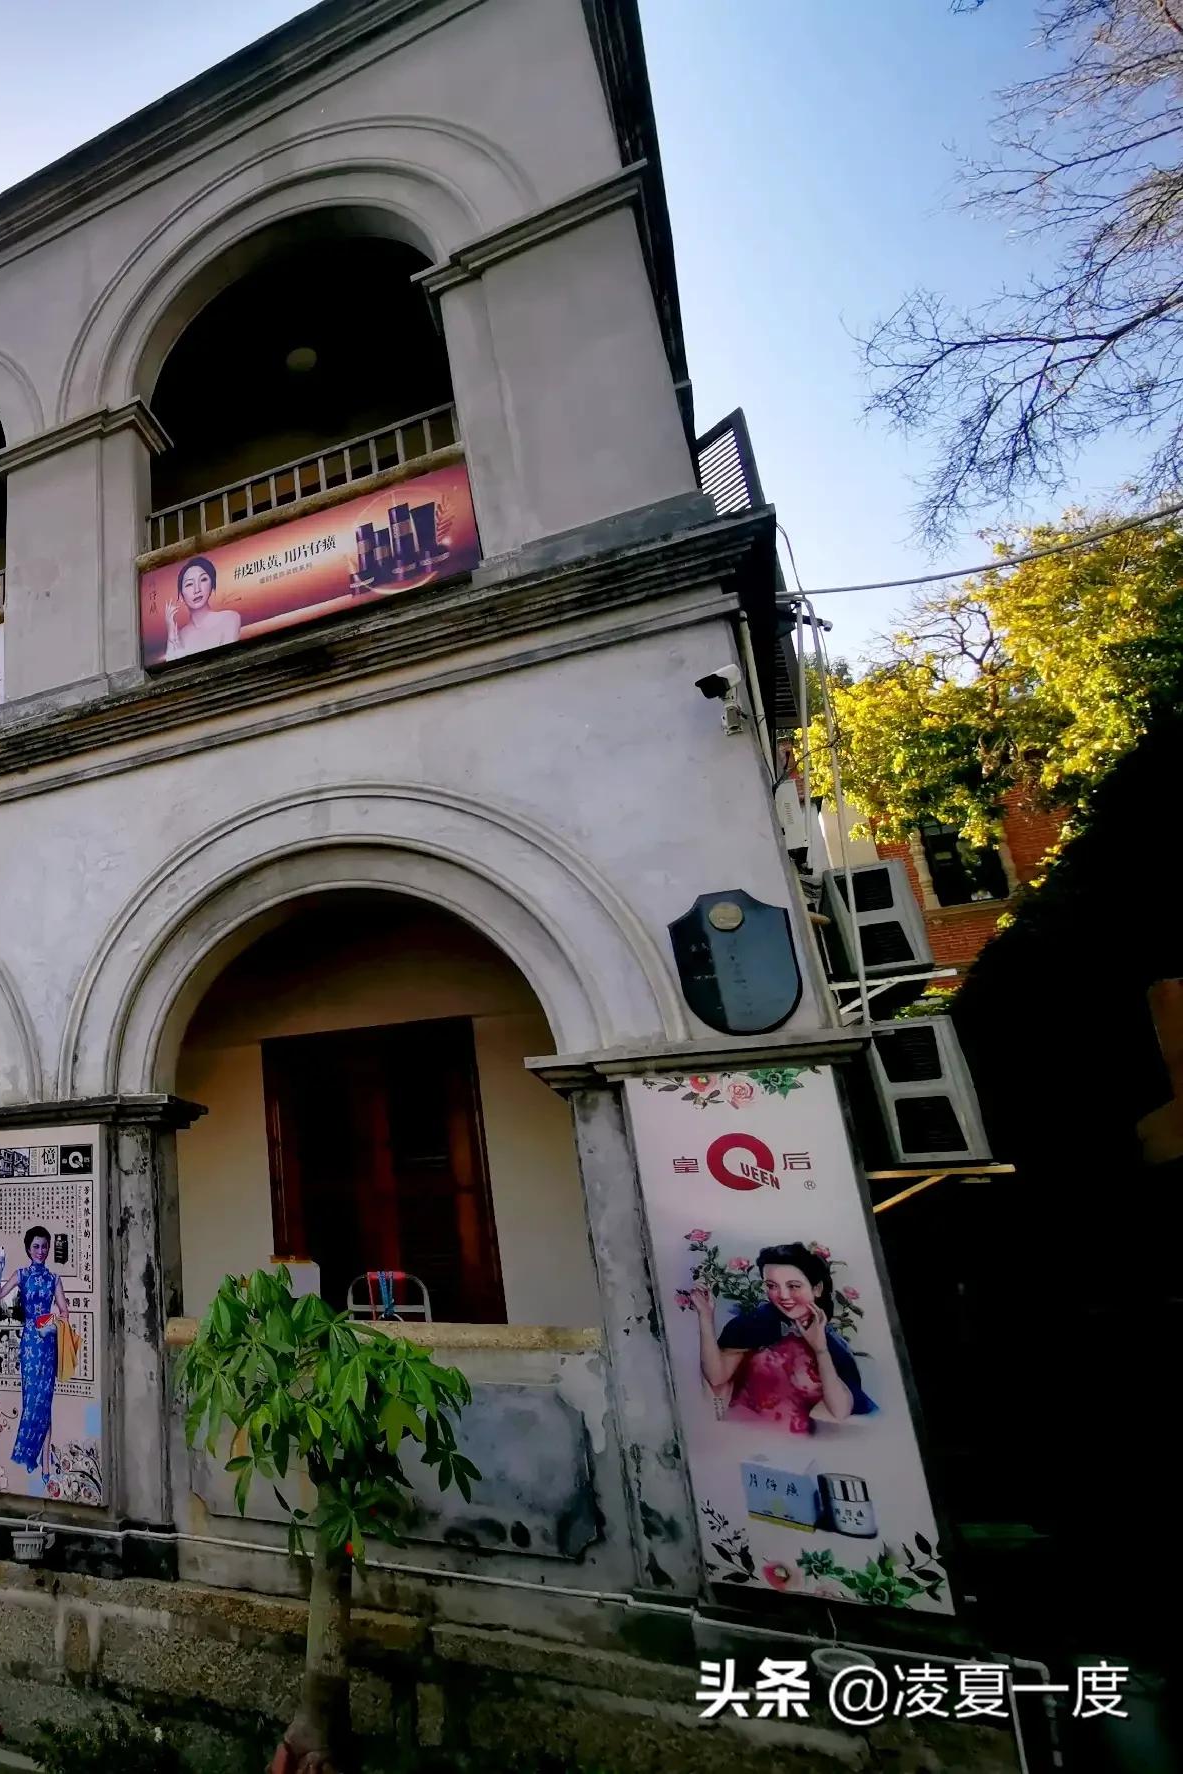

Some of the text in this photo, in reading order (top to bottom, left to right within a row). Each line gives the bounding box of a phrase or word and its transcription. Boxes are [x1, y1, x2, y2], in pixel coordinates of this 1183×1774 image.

[672, 1155, 700, 1175] 皇
[706, 1132, 781, 1191] QUEEN
[782, 1151, 812, 1171] 后
